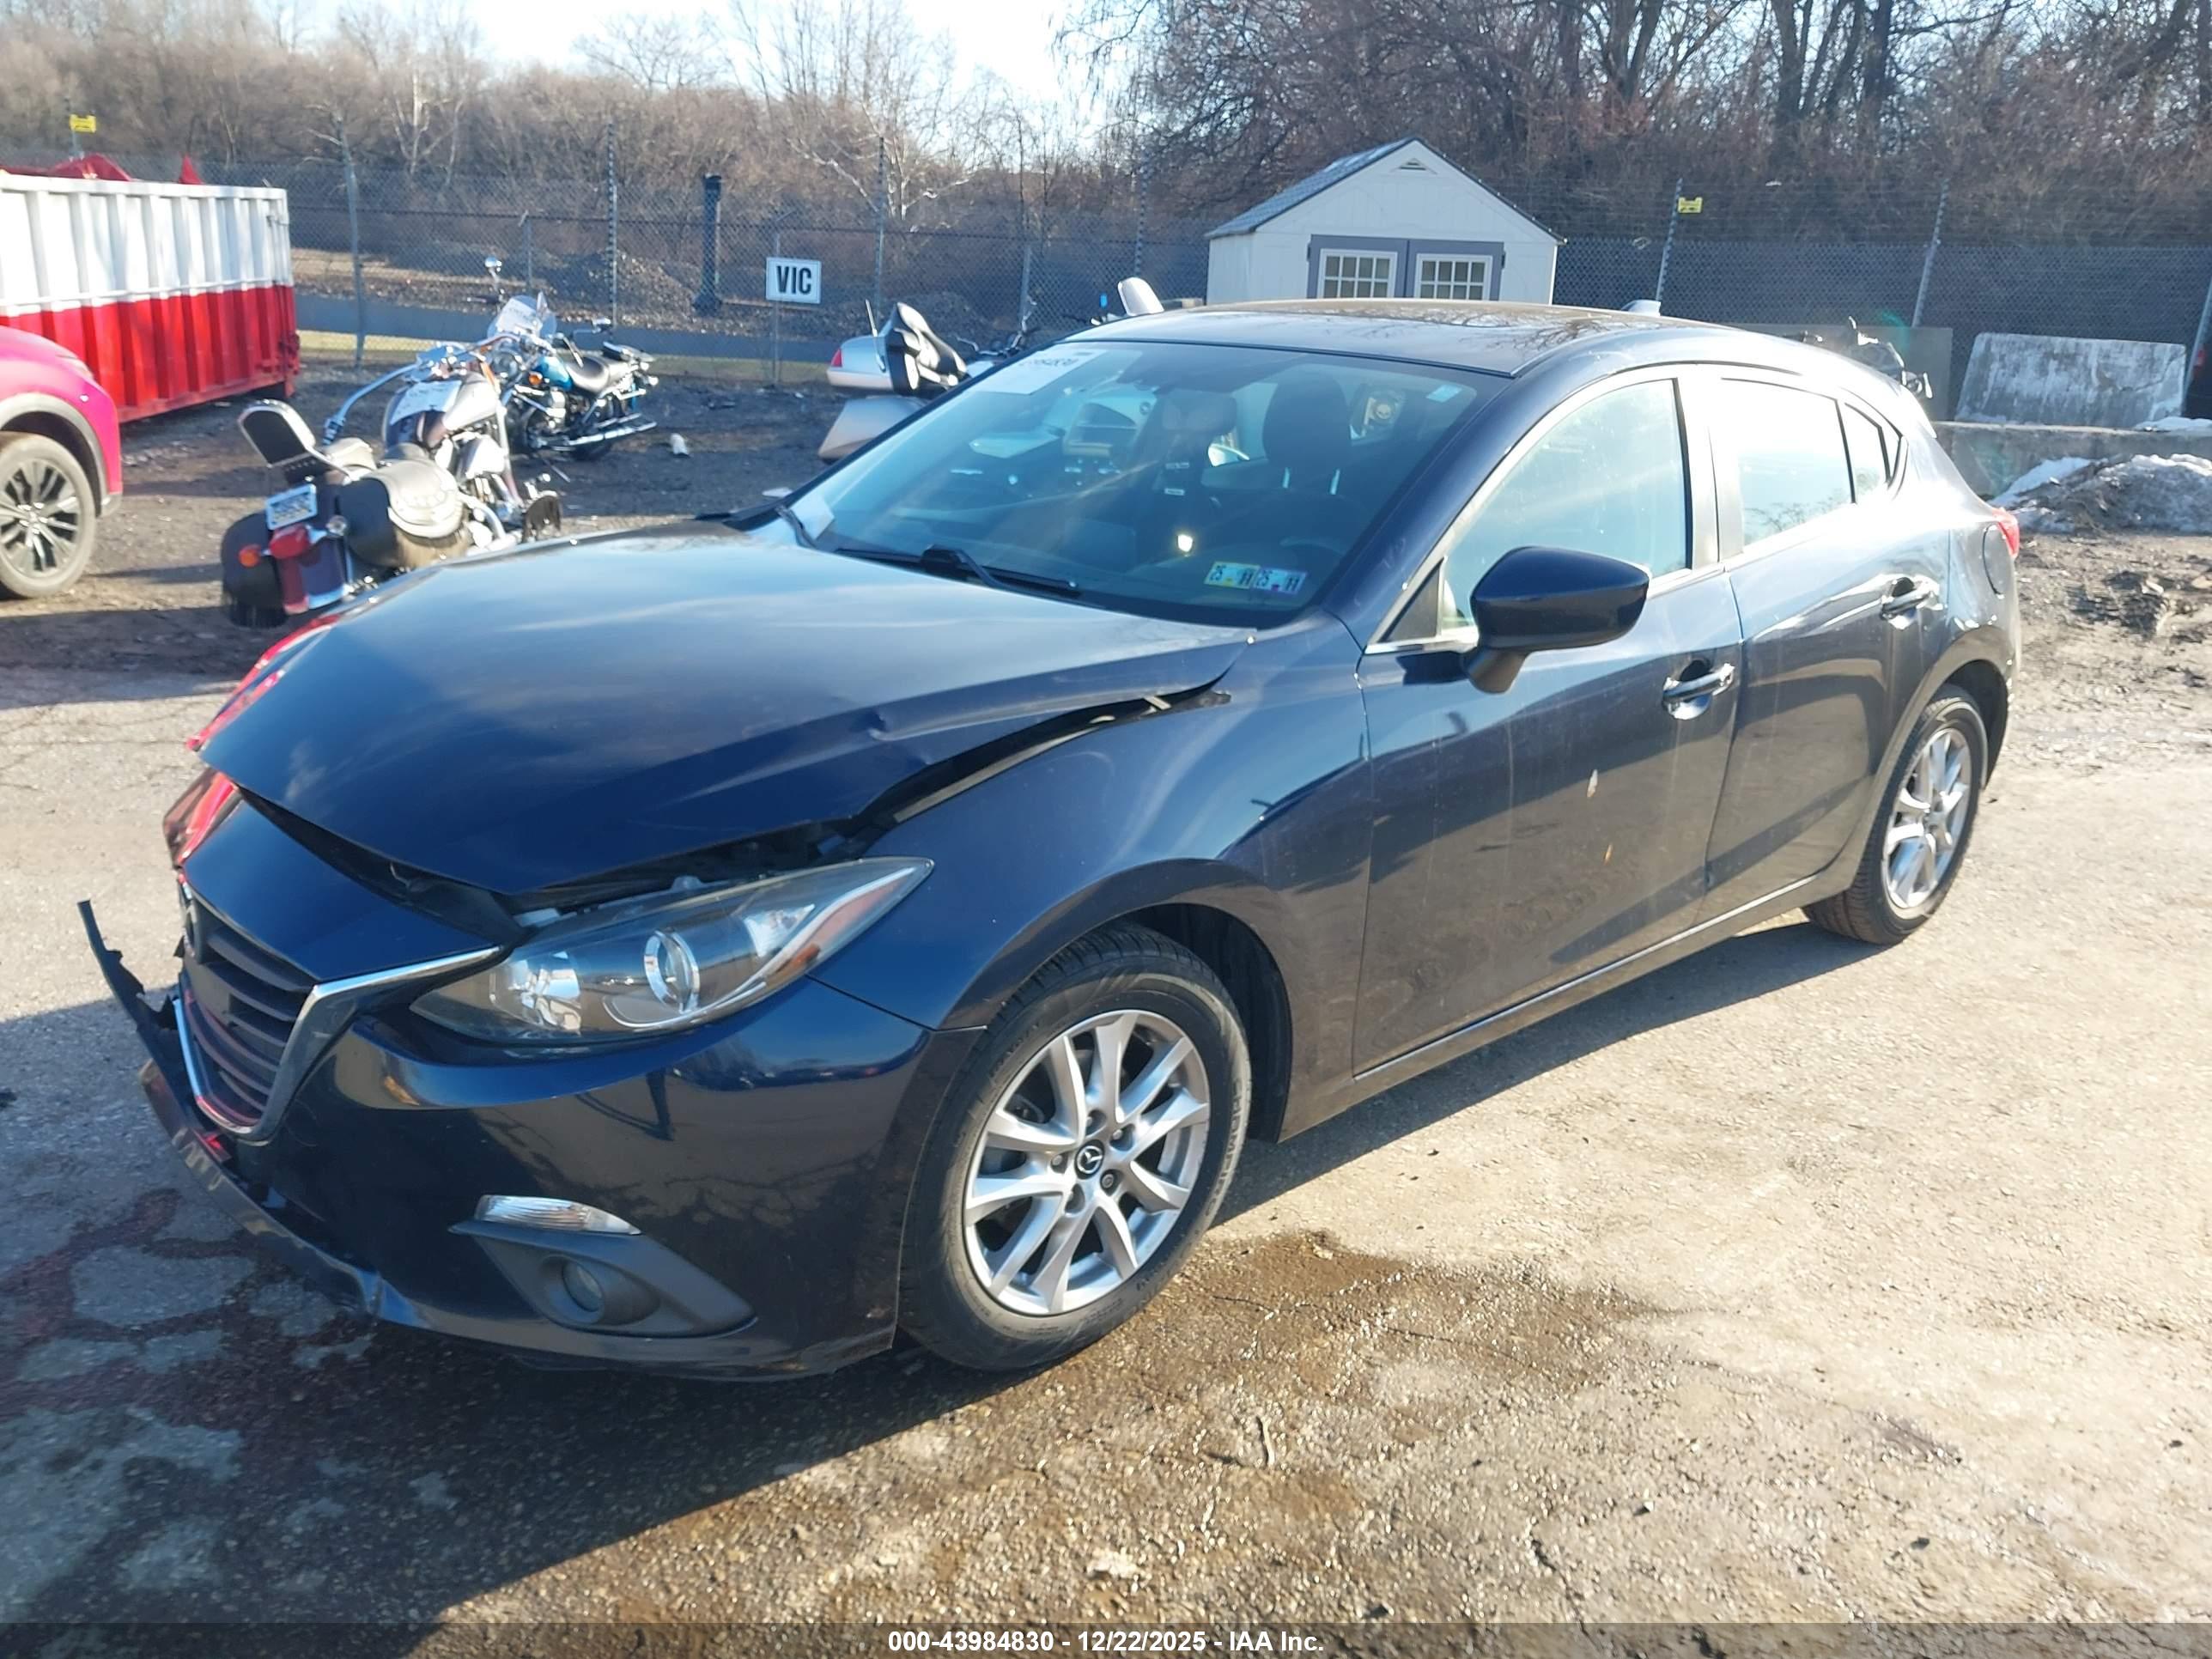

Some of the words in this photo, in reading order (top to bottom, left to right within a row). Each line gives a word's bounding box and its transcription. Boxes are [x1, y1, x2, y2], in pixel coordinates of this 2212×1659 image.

[776, 265, 811, 295] VIC
[1209, 564, 1226, 582] 25
[1239, 570, 1255, 586] 11
[1255, 569, 1273, 586] 25
[1285, 576, 1300, 591] 11
